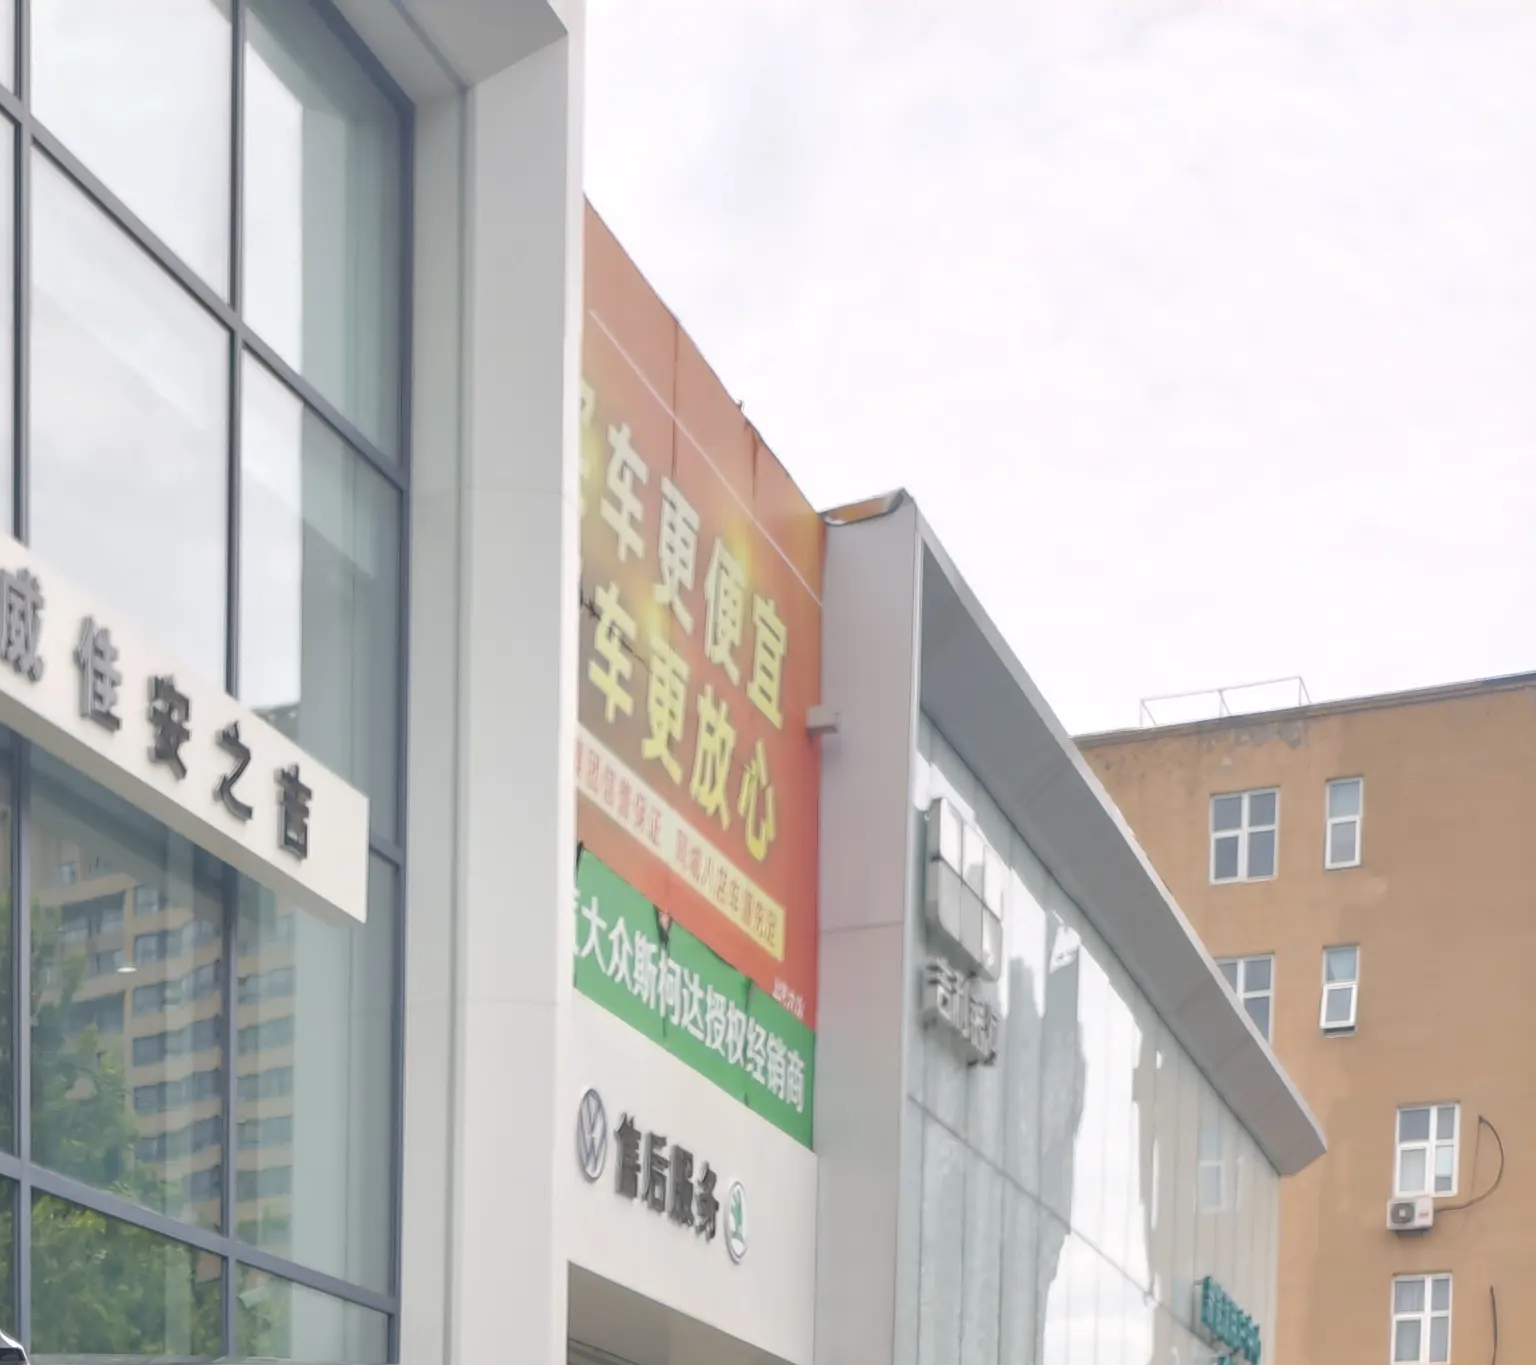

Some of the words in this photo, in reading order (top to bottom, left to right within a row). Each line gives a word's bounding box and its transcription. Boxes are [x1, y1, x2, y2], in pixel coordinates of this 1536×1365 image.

[580, 378, 788, 730] 车更便宜
[588, 582, 777, 862] 车更放心
[574, 888, 805, 1113] 大众斯柯达授权经销商
[614, 1111, 719, 1243] 售后服务
